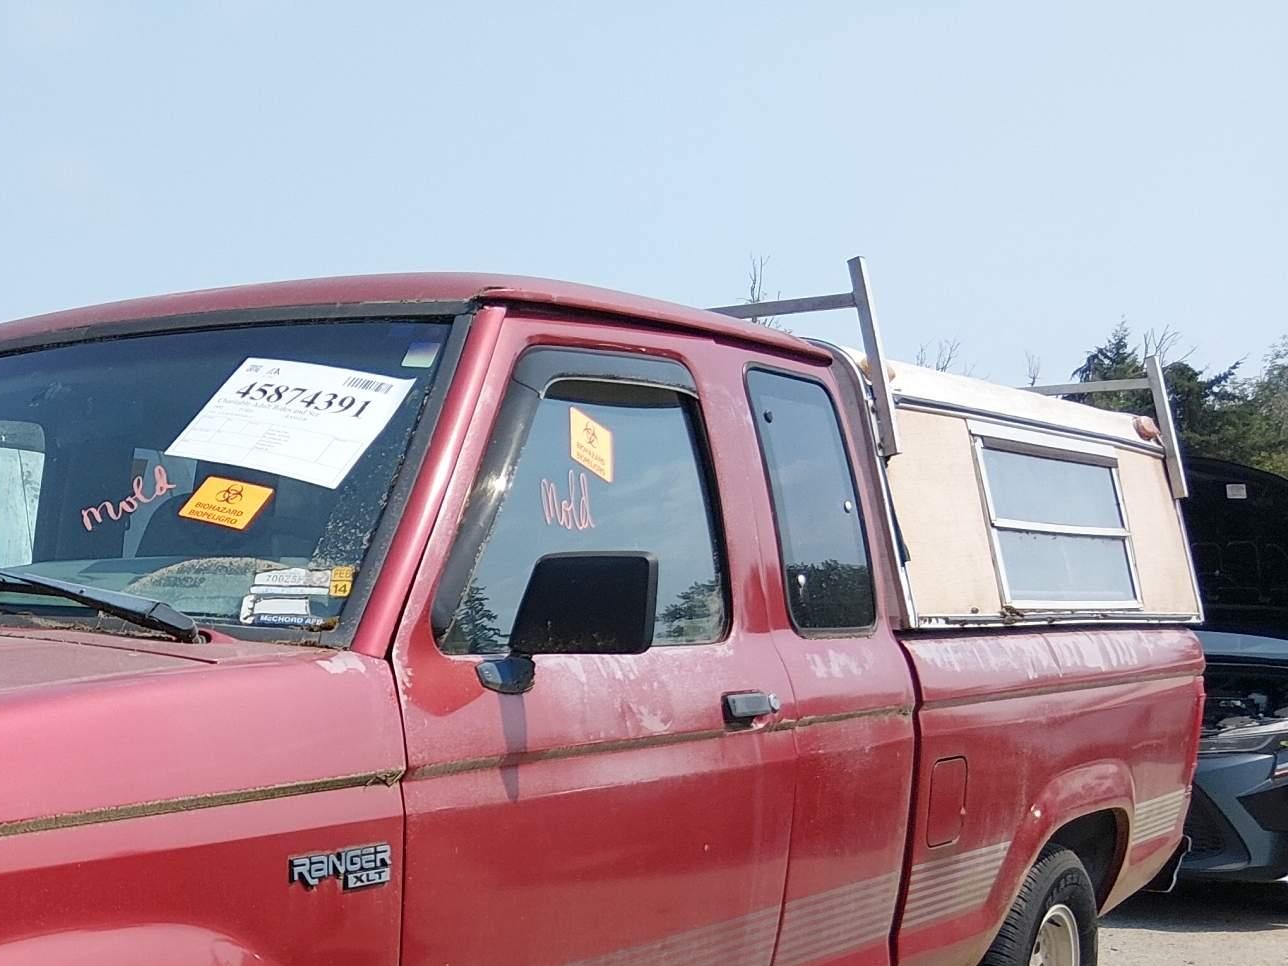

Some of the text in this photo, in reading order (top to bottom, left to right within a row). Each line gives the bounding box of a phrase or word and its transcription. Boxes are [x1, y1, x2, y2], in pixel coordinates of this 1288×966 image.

[236, 381, 372, 419] 45874391
[188, 509, 238, 525] BIOPELIGRO
[194, 501, 244, 517] BIOHAZARD
[333, 583, 348, 595] 14
[290, 844, 392, 886] RANGER
[351, 870, 387, 885] XLT
